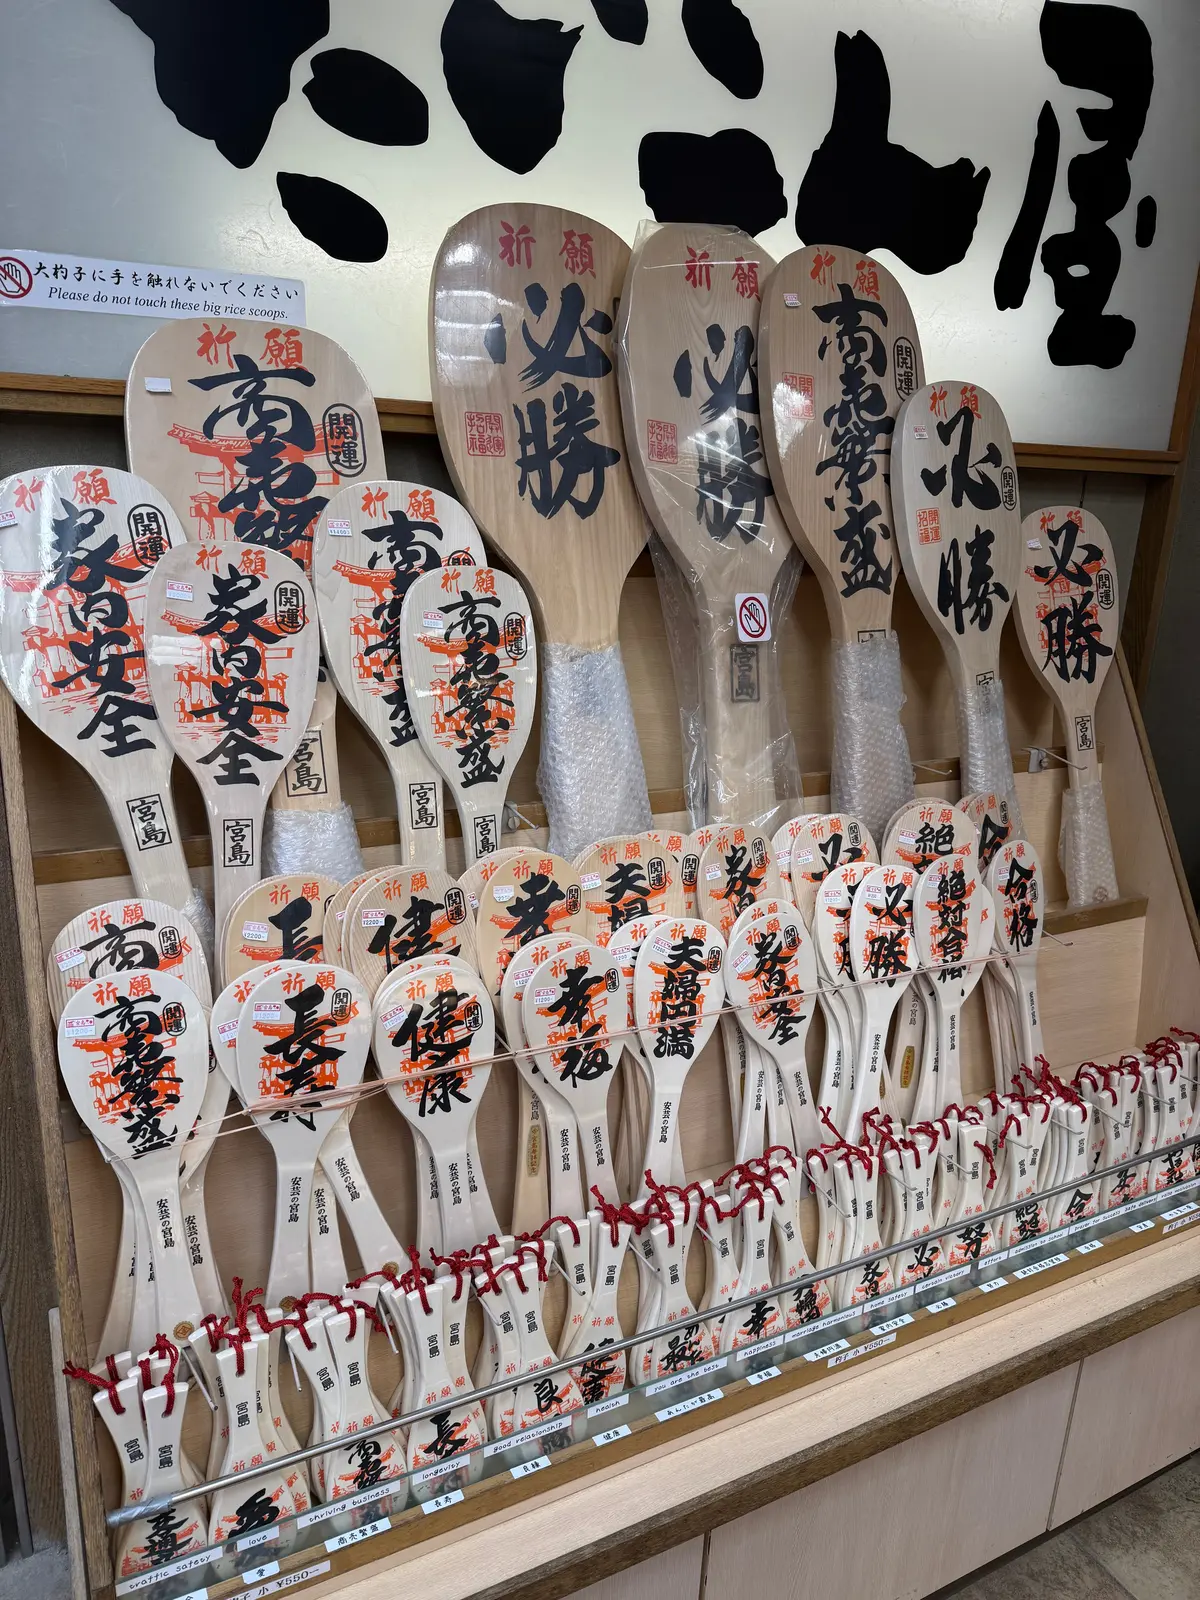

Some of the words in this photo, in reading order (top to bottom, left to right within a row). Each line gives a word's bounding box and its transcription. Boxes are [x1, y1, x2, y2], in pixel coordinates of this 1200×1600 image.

[499, 220, 597, 279] 祈願
[33, 261, 299, 300] 大杓子に手を触れないでください
[685, 245, 762, 302] 祈願
[810, 247, 881, 301] 祈願
[49, 286, 90, 303] Please
[93, 290, 109, 304] do
[111, 293, 132, 306] not
[134, 294, 168, 310] touch
[170, 297, 200, 312] these
[202, 300, 222, 317] big
[223, 303, 247, 316] rice
[248, 307, 289, 321] scoops.
[197, 323, 310, 372] 祈願
[896, 345, 914, 396] 開運
[484, 282, 622, 520] 必勝
[930, 384, 983, 420] 祈願
[328, 411, 364, 470] 開運
[673, 323, 775, 544] 必勝
[13, 467, 117, 515] 祈願
[362, 486, 440, 524] 祈願
[1002, 471, 1016, 507] 開運
[132, 510, 167, 562] 開運
[920, 405, 1009, 635] 必勝
[1040, 509, 1086, 534] 祈願
[195, 546, 270, 578] 祈願
[439, 567, 498, 597] 祈願
[1097, 571, 1113, 607] 開運
[277, 585, 303, 631] 開運
[1034, 519, 1113, 684] 必勝
[45, 497, 161, 759] 家内安全
[506, 617, 525, 656] 開運
[189, 562, 291, 787] 家内安全
[733, 645, 756, 699] 宮島
[437, 591, 514, 789] 商売繁盛
[1076, 717, 1093, 750] 宮島
[294, 738, 324, 795] 宮島
[410, 784, 435, 828] 宮島
[920, 806, 953, 824] 祈願
[976, 794, 998, 816] 祈願
[130, 799, 168, 847] 宮島
[475, 816, 496, 856] 宮島
[811, 817, 843, 840] 祈願
[850, 823, 860, 845] 開運
[225, 820, 252, 866] 宮島
[601, 842, 641, 866] 祈願
[717, 827, 747, 853] 祈願
[754, 838, 765, 867] 開運
[1004, 843, 1026, 864] 祈願
[512, 858, 554, 881] 祈願
[651, 859, 664, 888] 開運
[685, 855, 698, 885] 開運
[884, 867, 914, 887] 祈願
[938, 856, 965, 877] 祈願
[268, 880, 321, 905] 祈願
[384, 870, 429, 902] 祈願
[568, 889, 580, 915] 開運
[87, 901, 145, 933] 祈願
[446, 889, 464, 923] 開運
[161, 929, 180, 957] 開運
[243, 929, 267, 941] ¥2200-
[670, 923, 707, 942] 祈願
[746, 916, 782, 946] 祈願
[787, 926, 798, 950] 開運
[863, 881, 914, 988] 必勝
[550, 949, 593, 979] 祈願
[709, 948, 722, 973] 開運
[93, 973, 155, 1006] 祈願
[280, 970, 337, 995] 祈願
[407, 971, 456, 1002] 祈願
[606, 969, 620, 992] 開運
[754, 932, 807, 1047] 家内安全
[333, 989, 350, 1021] 開運
[653, 935, 708, 1060] 夫婦円満
[165, 1003, 186, 1034] 開運
[466, 1003, 482, 1031] 開運
[870, 1033, 882, 1074] 安芸の宮島
[93, 993, 184, 1161] 商売繁盛
[754, 1070, 765, 1112] 安芸の宮島
[658, 1101, 672, 1144] 安芸の宮島
[560, 1128, 571, 1173] 安芸の宮島
[592, 1126, 605, 1167] 安芸の宮島
[334, 1156, 361, 1202] 安芸の宮島
[448, 1162, 462, 1206] 安芸の宮島
[287, 1176, 302, 1223] 安芸の宮島
[313, 1188, 330, 1236] 安芸の宮島
[156, 1198, 175, 1249] 安芸の宮島
[184, 1214, 203, 1267] 安芸の宮島
[945, 1268, 965, 1281] victory
[869, 1299, 885, 1310] home
[887, 1290, 908, 1304] safety
[791, 1323, 820, 1340] marriage
[821, 1310, 856, 1328] harmonious
[743, 1339, 777, 1358] happiness
[653, 1383, 667, 1393] you
[669, 1376, 684, 1386] are
[686, 1370, 700, 1380] the
[703, 1362, 720, 1373] best
[594, 1400, 621, 1415] health
[493, 1440, 513, 1454] good
[515, 1421, 563, 1445] relationship
[602, 1429, 621, 1441] 健康
[421, 1460, 462, 1481] longevity
[308, 1503, 348, 1523] thriving
[351, 1487, 390, 1506] business
[248, 1534, 268, 1546] love
[337, 1523, 379, 1546] 商売繁盛
[129, 1571, 170, 1590] traffic
[175, 1554, 212, 1574] safety
[258, 1586, 270, 1597] 小
